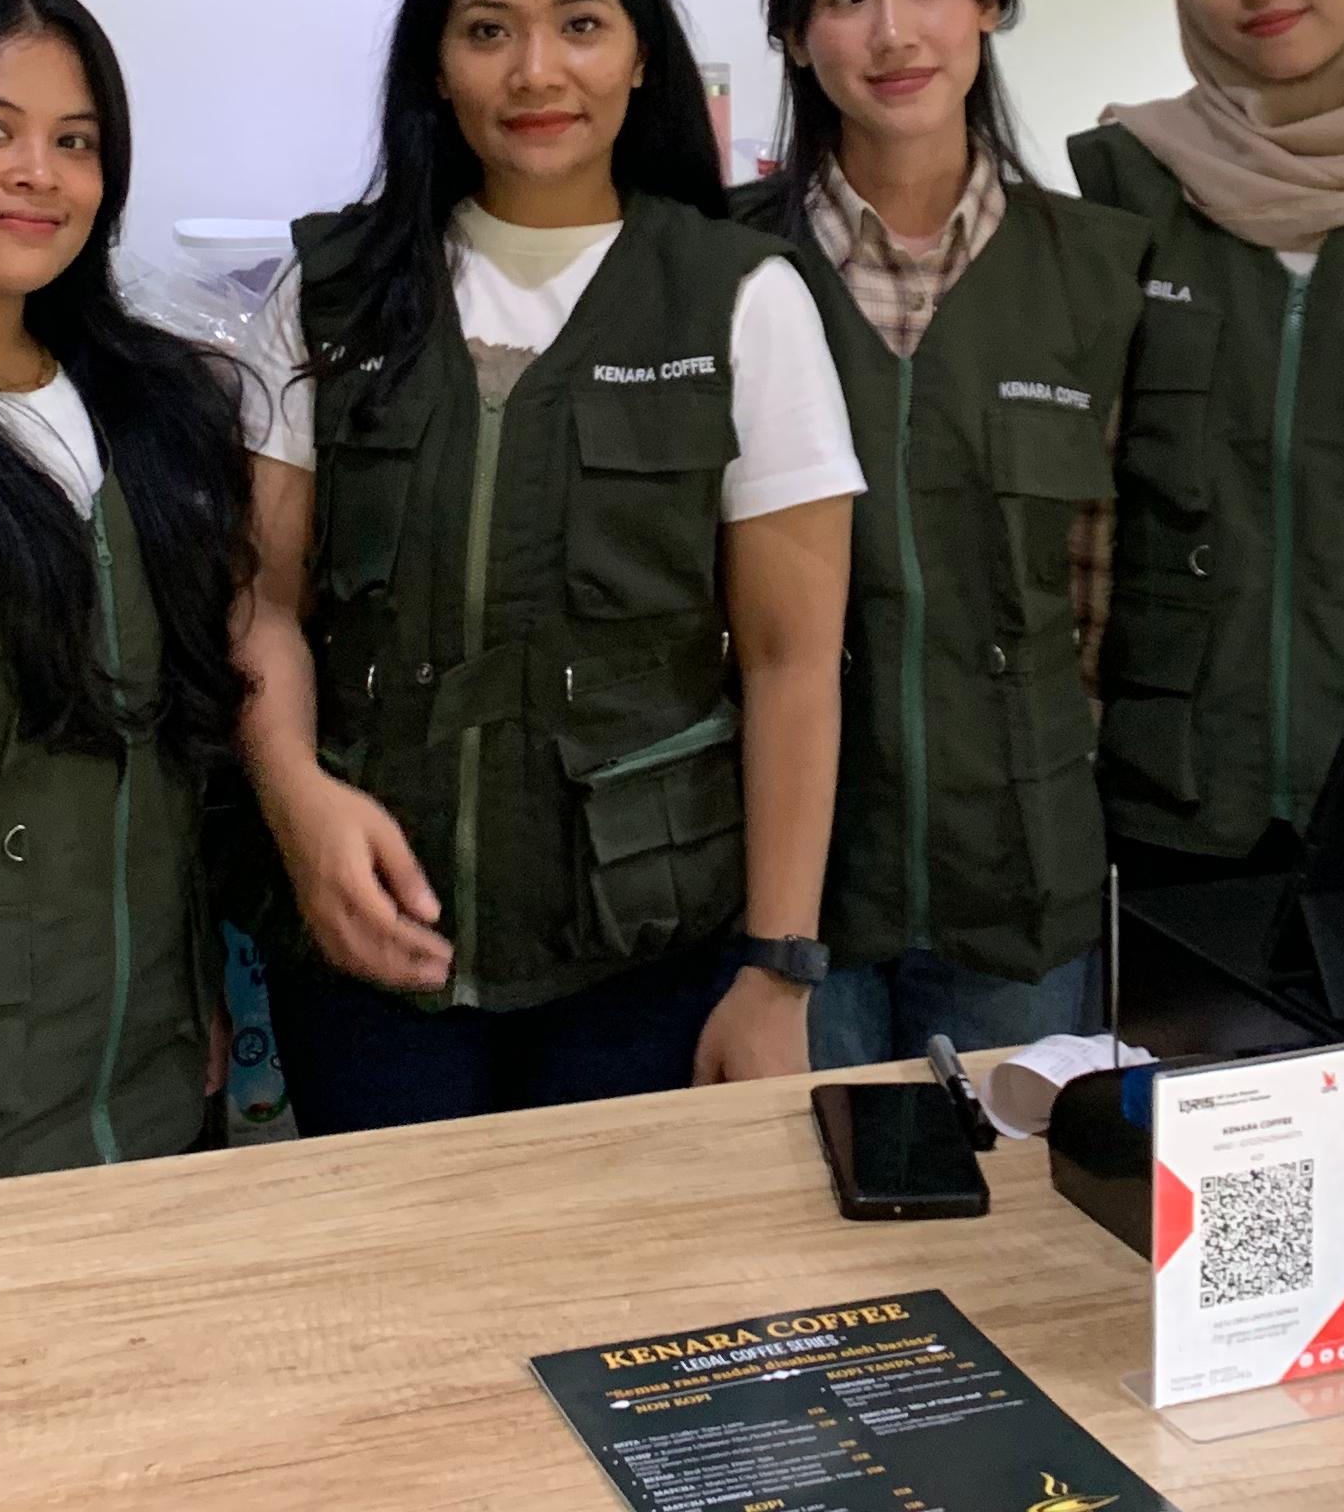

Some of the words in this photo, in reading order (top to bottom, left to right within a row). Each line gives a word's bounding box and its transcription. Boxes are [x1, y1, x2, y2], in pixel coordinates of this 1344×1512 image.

[593, 363, 656, 385] KENARA
[660, 355, 716, 381] COFFEE
[999, 381, 1053, 401] KENARA
[600, 1326, 763, 1370] KENARA
[766, 1302, 910, 1346] COFFEE
[679, 1351, 730, 1373] LEGAL
[732, 1342, 787, 1364] COFFEE
[789, 1332, 840, 1352] SERIES
